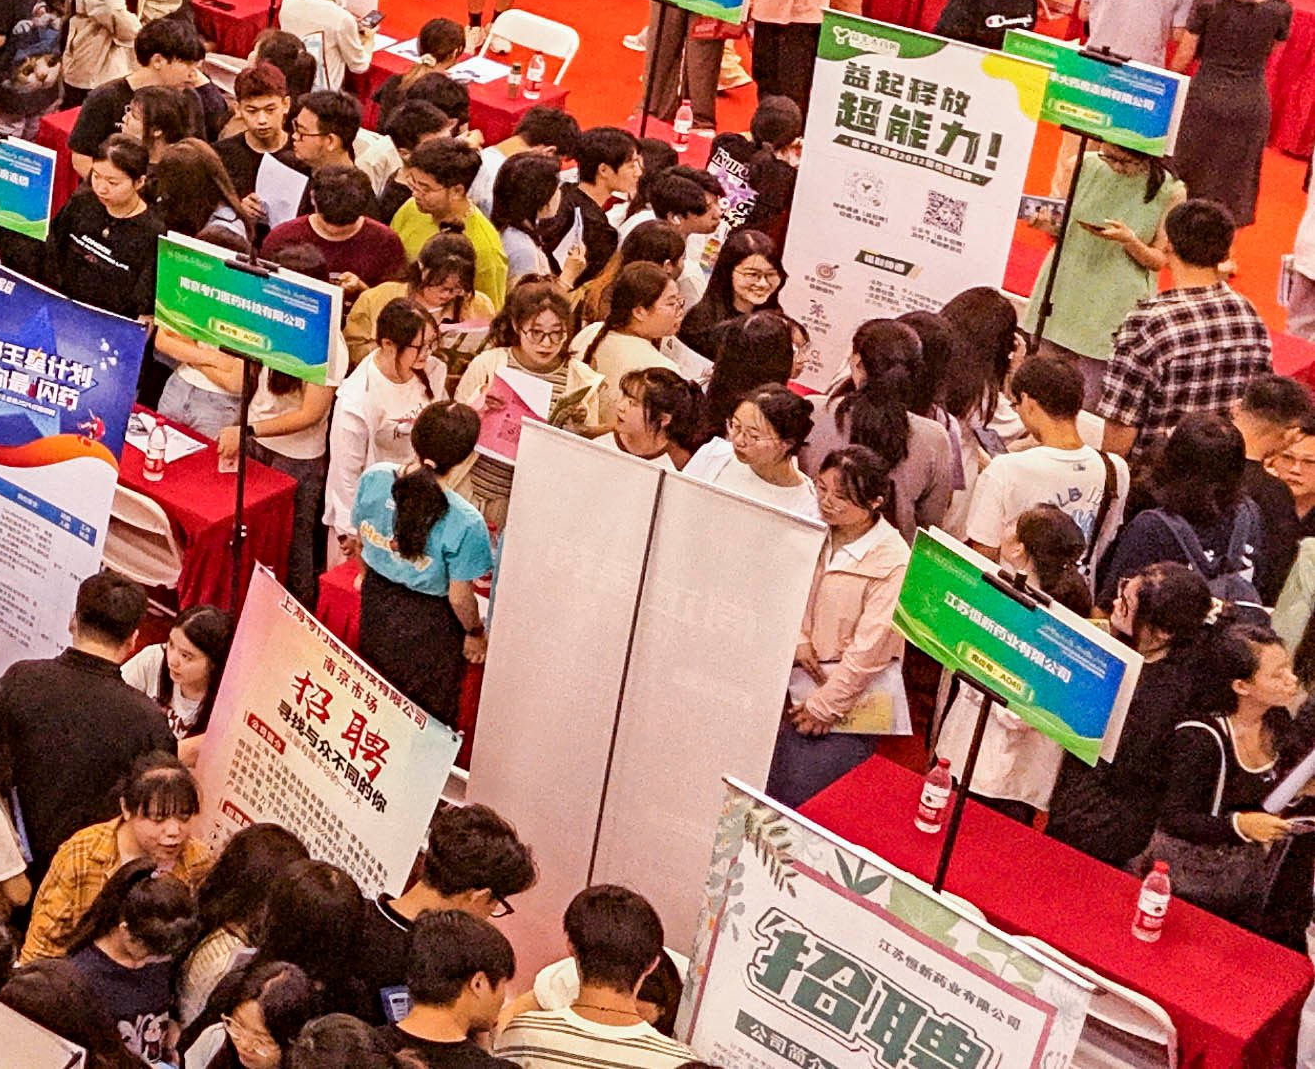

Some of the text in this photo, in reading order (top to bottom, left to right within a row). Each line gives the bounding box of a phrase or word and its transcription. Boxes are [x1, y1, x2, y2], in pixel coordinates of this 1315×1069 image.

[841, 60, 972, 117] 益起释放
[291, 670, 390, 780] 招聘
[322, 655, 378, 715] 南京市场
[277, 698, 388, 814] 寻找与众不同的你
[877, 937, 1022, 1031] 江苏恒新药业有限公司
